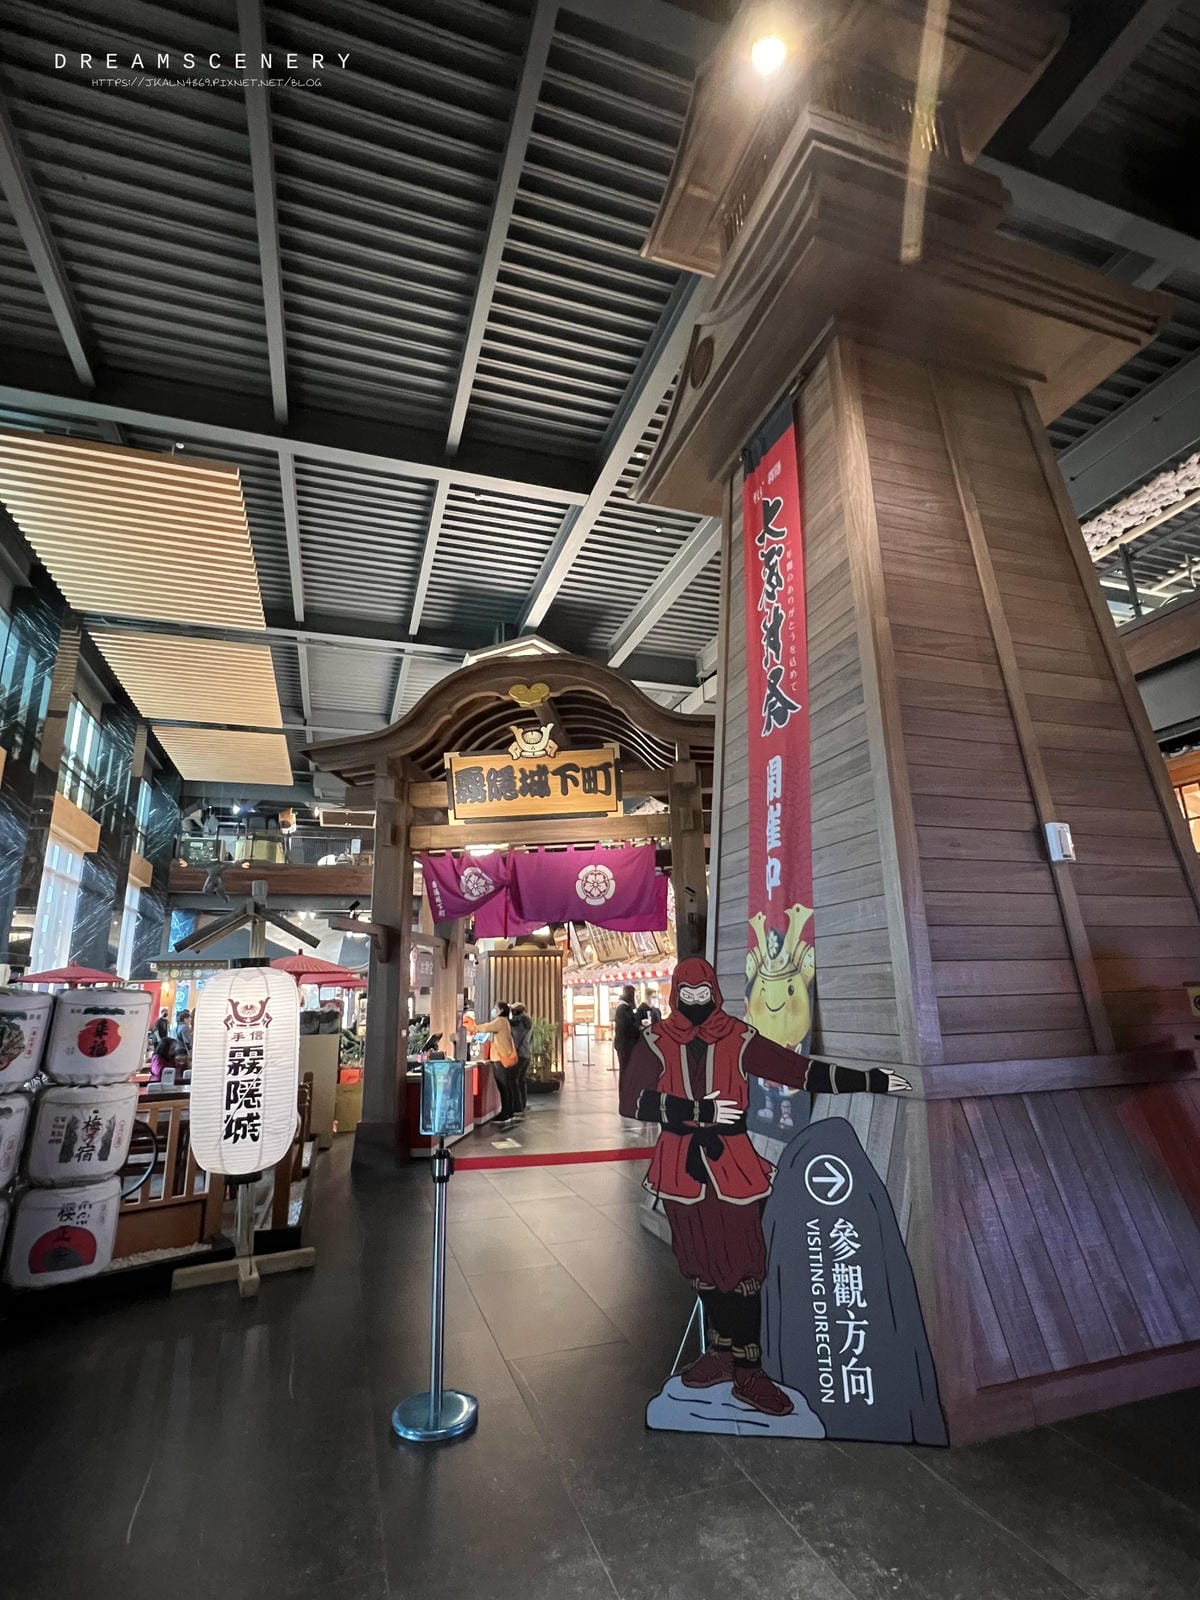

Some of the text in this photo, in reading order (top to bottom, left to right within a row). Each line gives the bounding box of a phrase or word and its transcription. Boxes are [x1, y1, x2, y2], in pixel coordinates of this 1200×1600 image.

[231, 1030, 264, 1042] 手信
[806, 1217, 836, 1404] VISITING DIRECTION
[828, 1217, 875, 1406] 參觀方向
